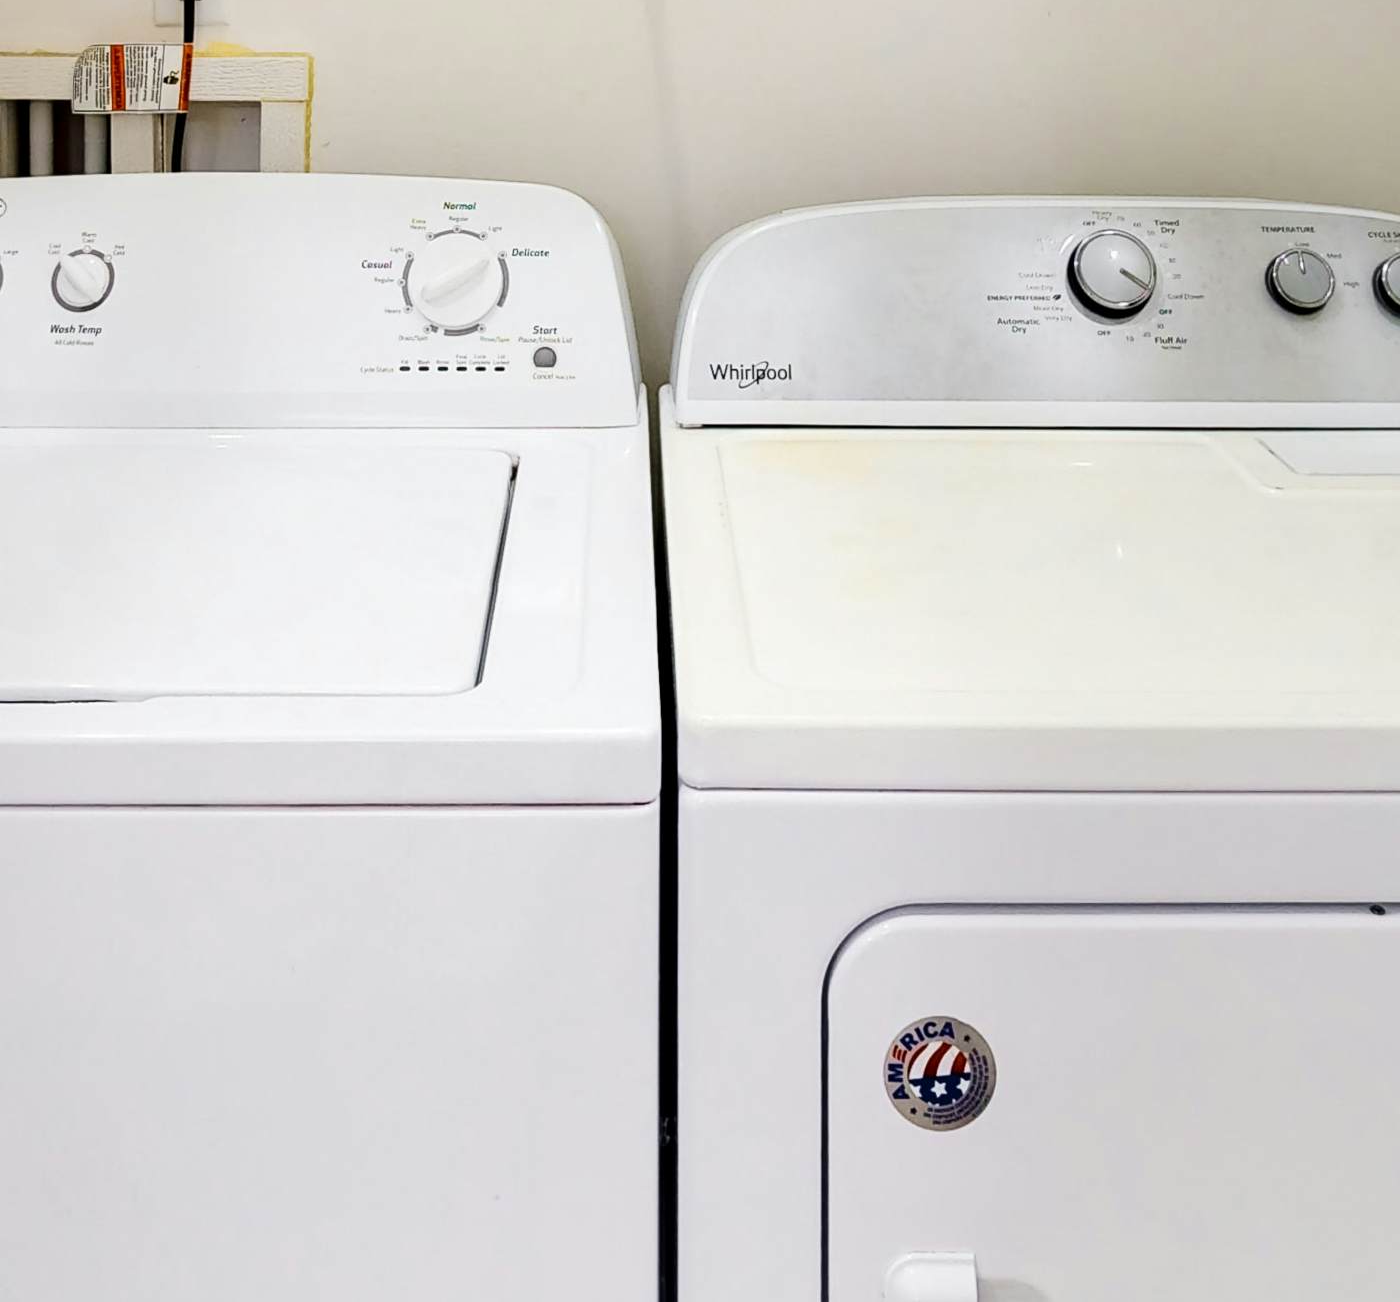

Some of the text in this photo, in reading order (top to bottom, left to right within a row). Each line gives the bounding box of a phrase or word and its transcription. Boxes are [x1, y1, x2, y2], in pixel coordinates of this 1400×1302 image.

[443, 201, 476, 211] Normal
[1154, 219, 1180, 227] Timed
[1160, 226, 1176, 235] Dry
[1260, 226, 1315, 234] TEMPERATURE
[512, 248, 550, 258] Delicate
[361, 259, 393, 269] Casual
[997, 317, 1041, 326] Automatic
[50, 324, 103, 336] Wash Temp
[532, 325, 558, 335] Start
[1012, 326, 1028, 334] Dry
[1154, 336, 1188, 344] Fluff Air
[532, 372, 554, 380] Cancel
[709, 362, 793, 387] Whirlpool
[886, 1020, 955, 1100] AMERICA
